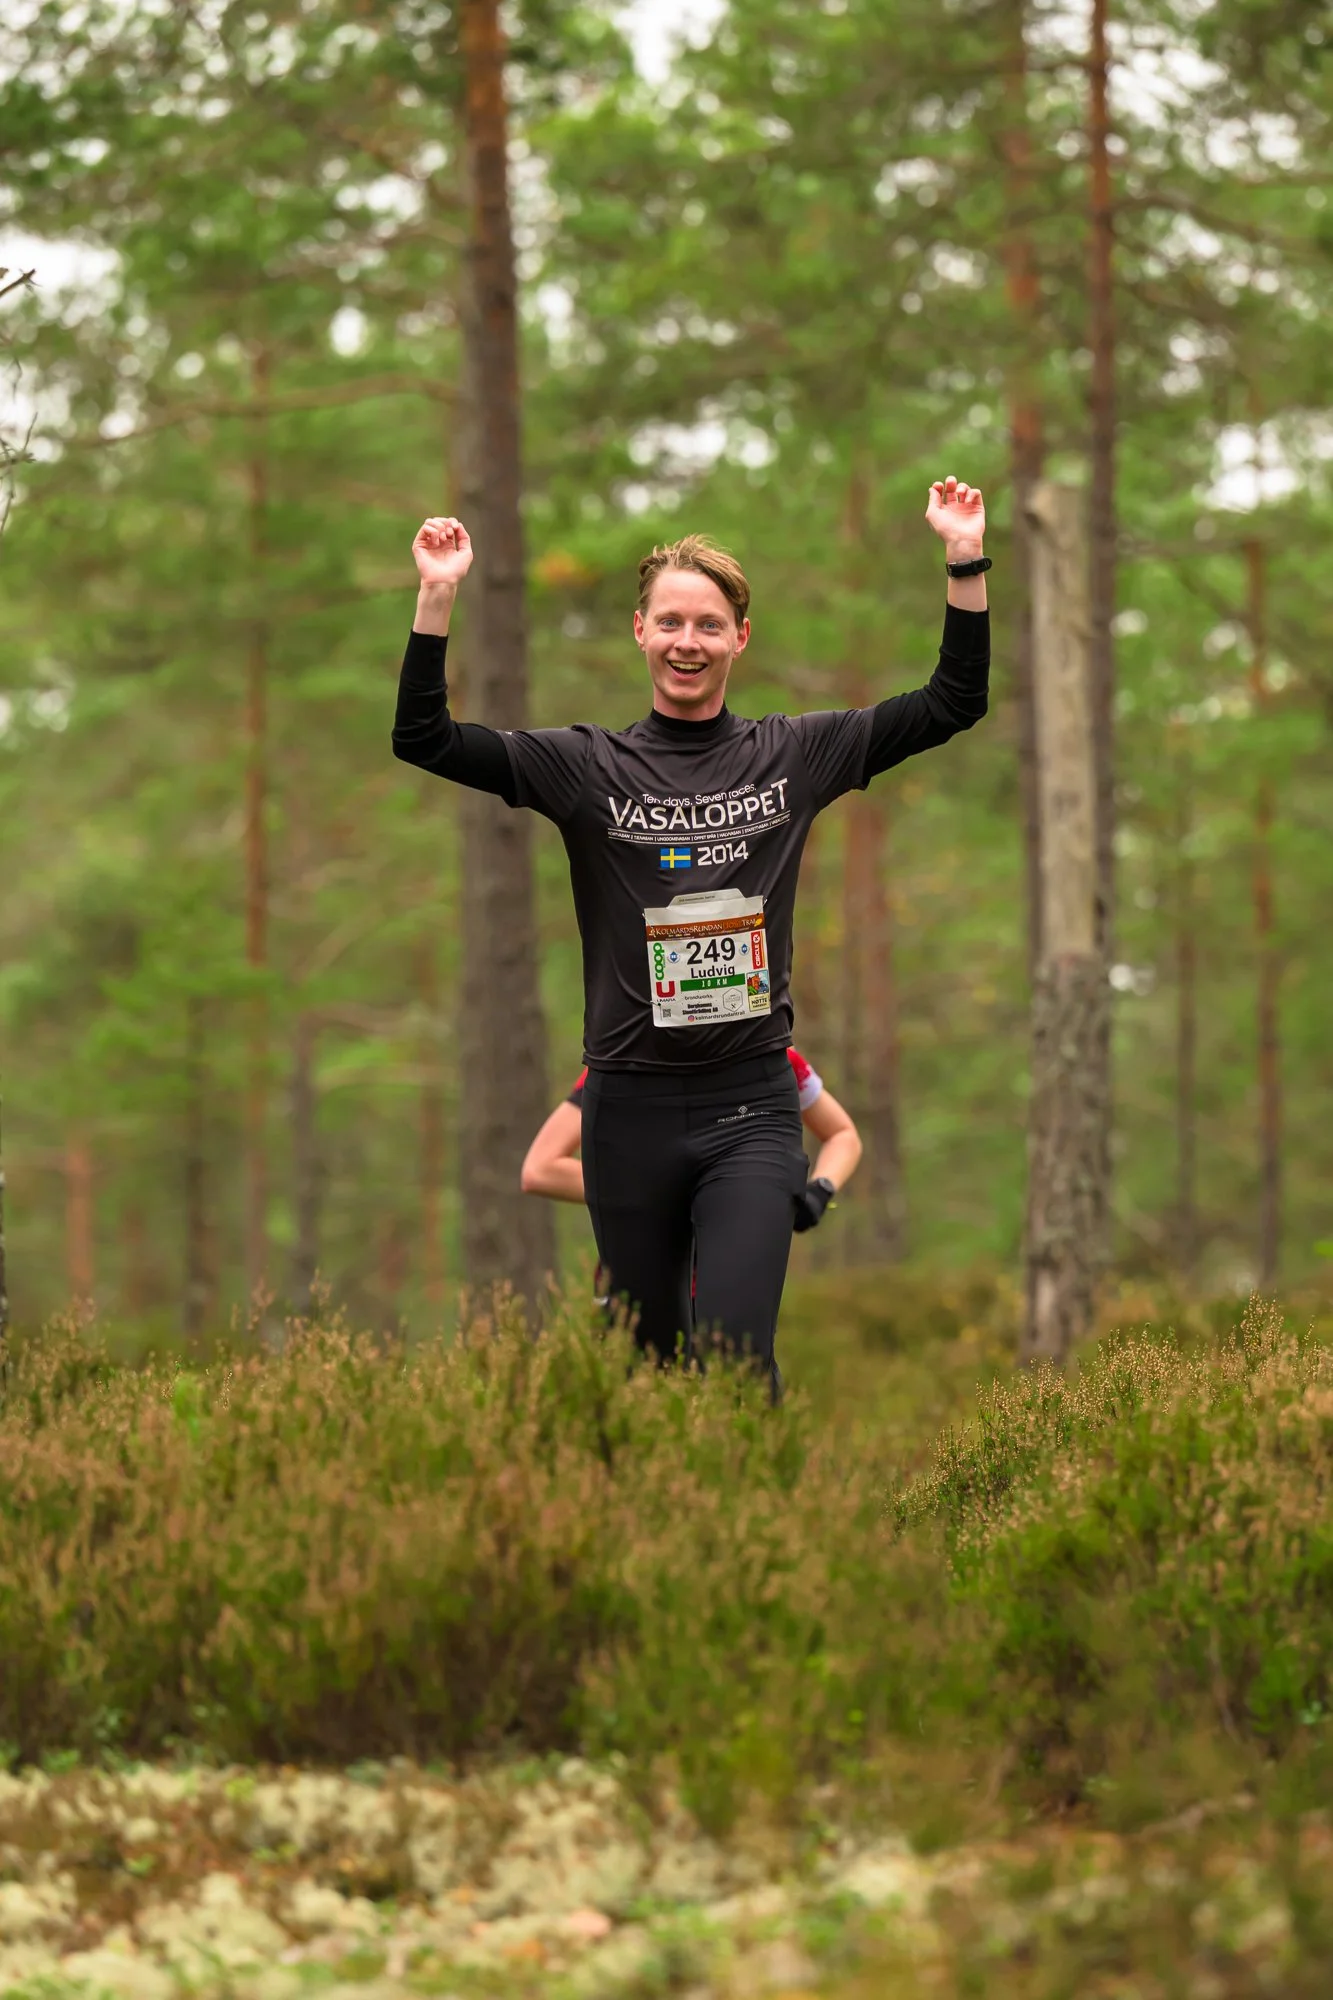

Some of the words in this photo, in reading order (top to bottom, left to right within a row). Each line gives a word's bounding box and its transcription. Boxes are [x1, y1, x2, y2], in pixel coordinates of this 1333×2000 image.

[608, 777, 788, 830] VASALOPPET
[642, 793, 661, 804] Ten
[662, 796, 693, 808] days.
[695, 792, 727, 804] Seven
[728, 782, 757, 801] races.
[697, 840, 749, 867] 2014
[653, 942, 665, 981] coop
[686, 937, 736, 966] 249
[690, 964, 736, 978] Ludvig
[701, 980, 711, 988] 10
[716, 977, 728, 986] KM
